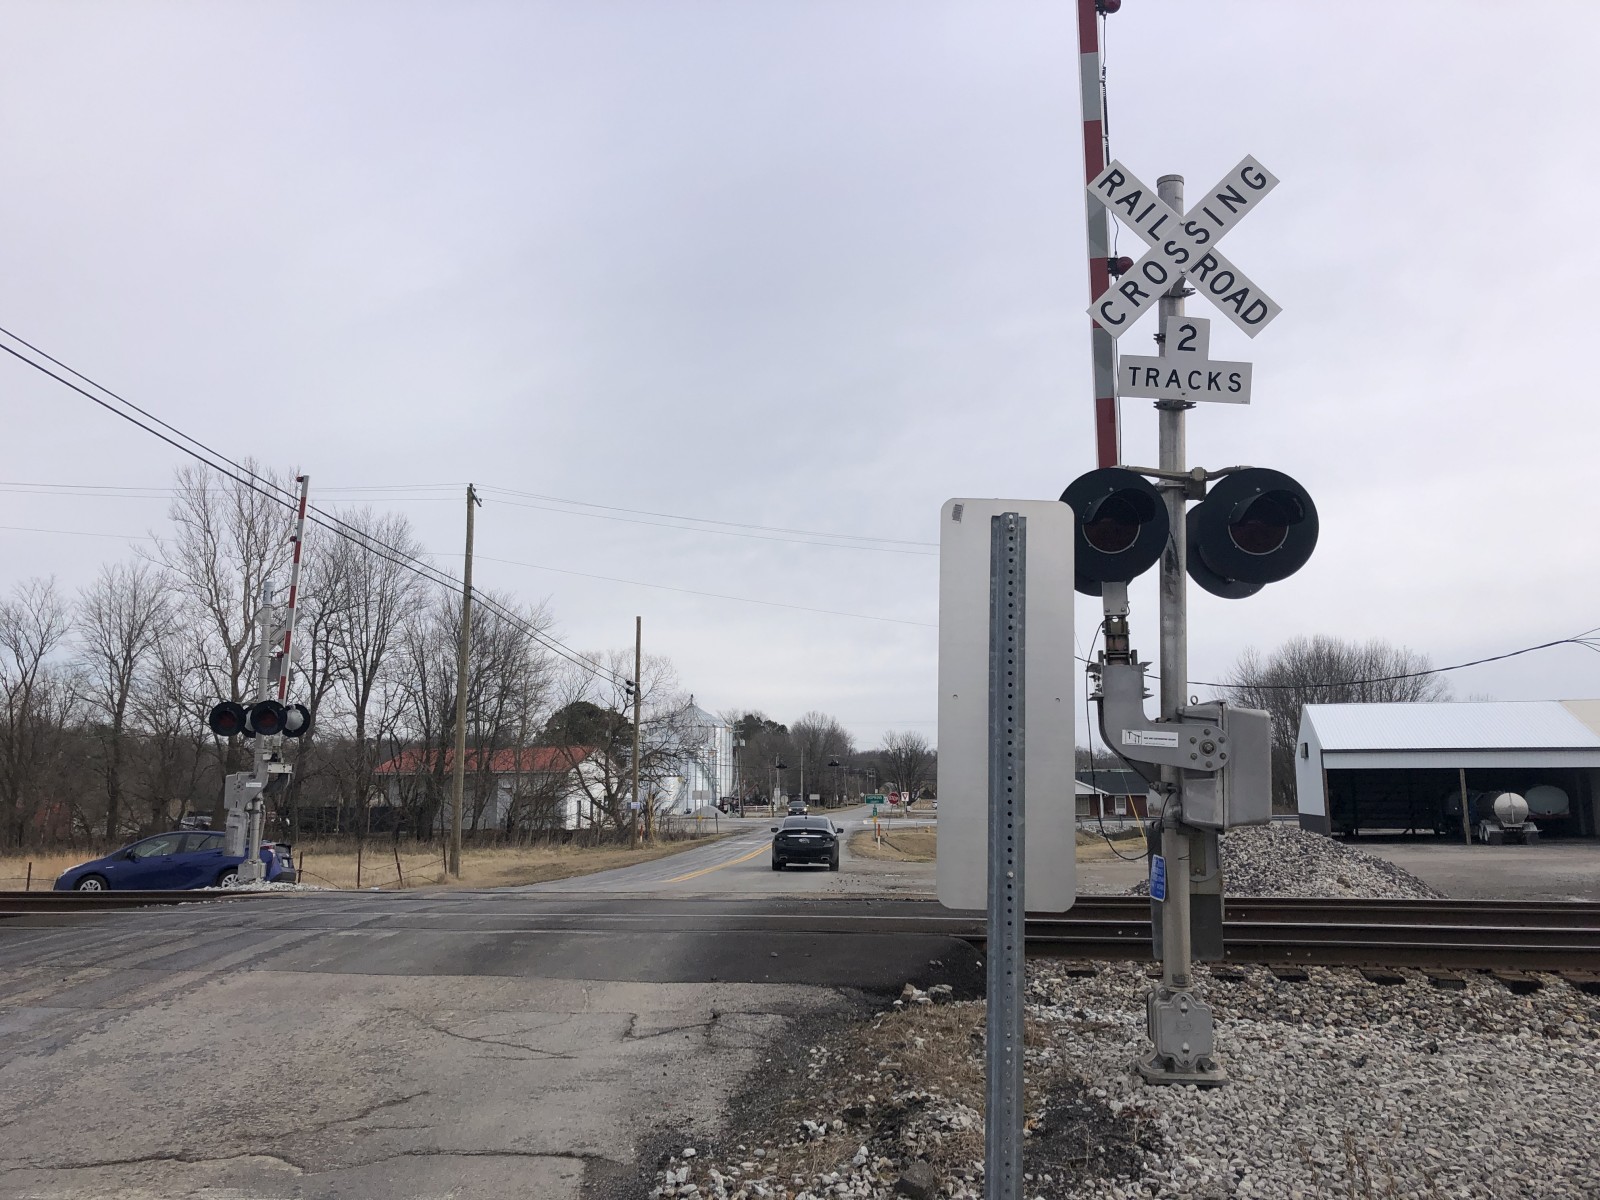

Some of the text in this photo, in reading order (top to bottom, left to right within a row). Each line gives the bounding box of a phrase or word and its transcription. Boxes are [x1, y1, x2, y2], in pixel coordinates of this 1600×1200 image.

[1100, 166, 1267, 326] CROSSING
[1177, 323, 1198, 352] 2
[1128, 366, 1242, 393] TRACKS
